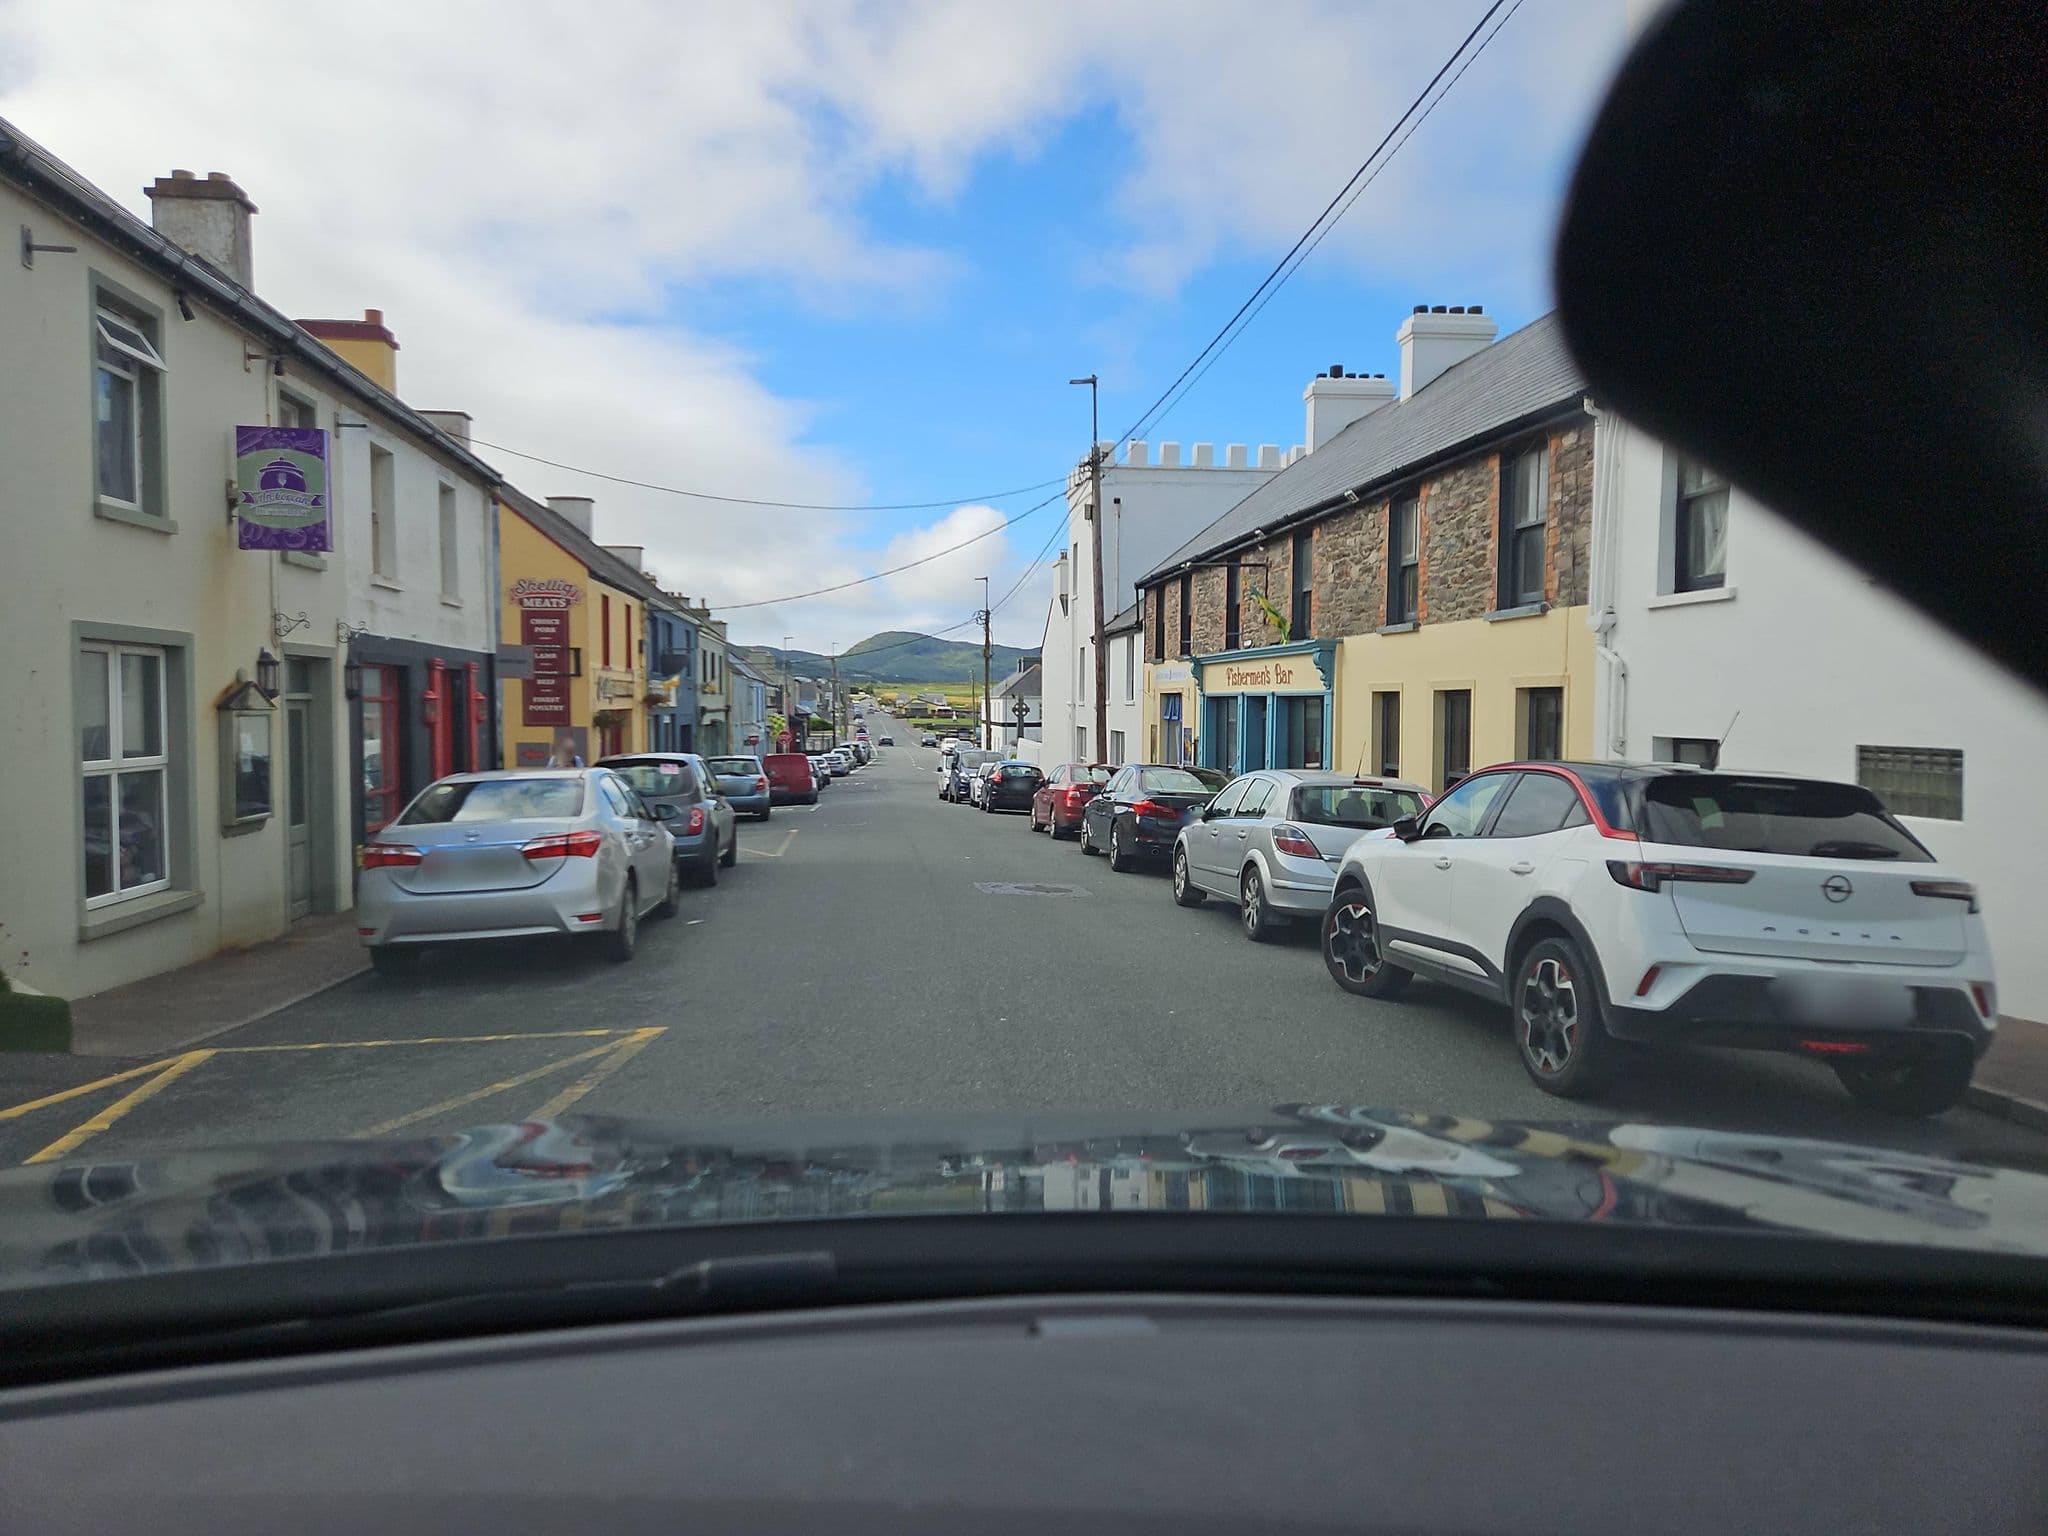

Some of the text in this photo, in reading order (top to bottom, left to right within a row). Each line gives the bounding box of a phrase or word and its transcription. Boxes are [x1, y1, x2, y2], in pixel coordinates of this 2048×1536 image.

[523, 598, 567, 608] MEATS
[1226, 662, 1294, 687] Fishermen's Bar
